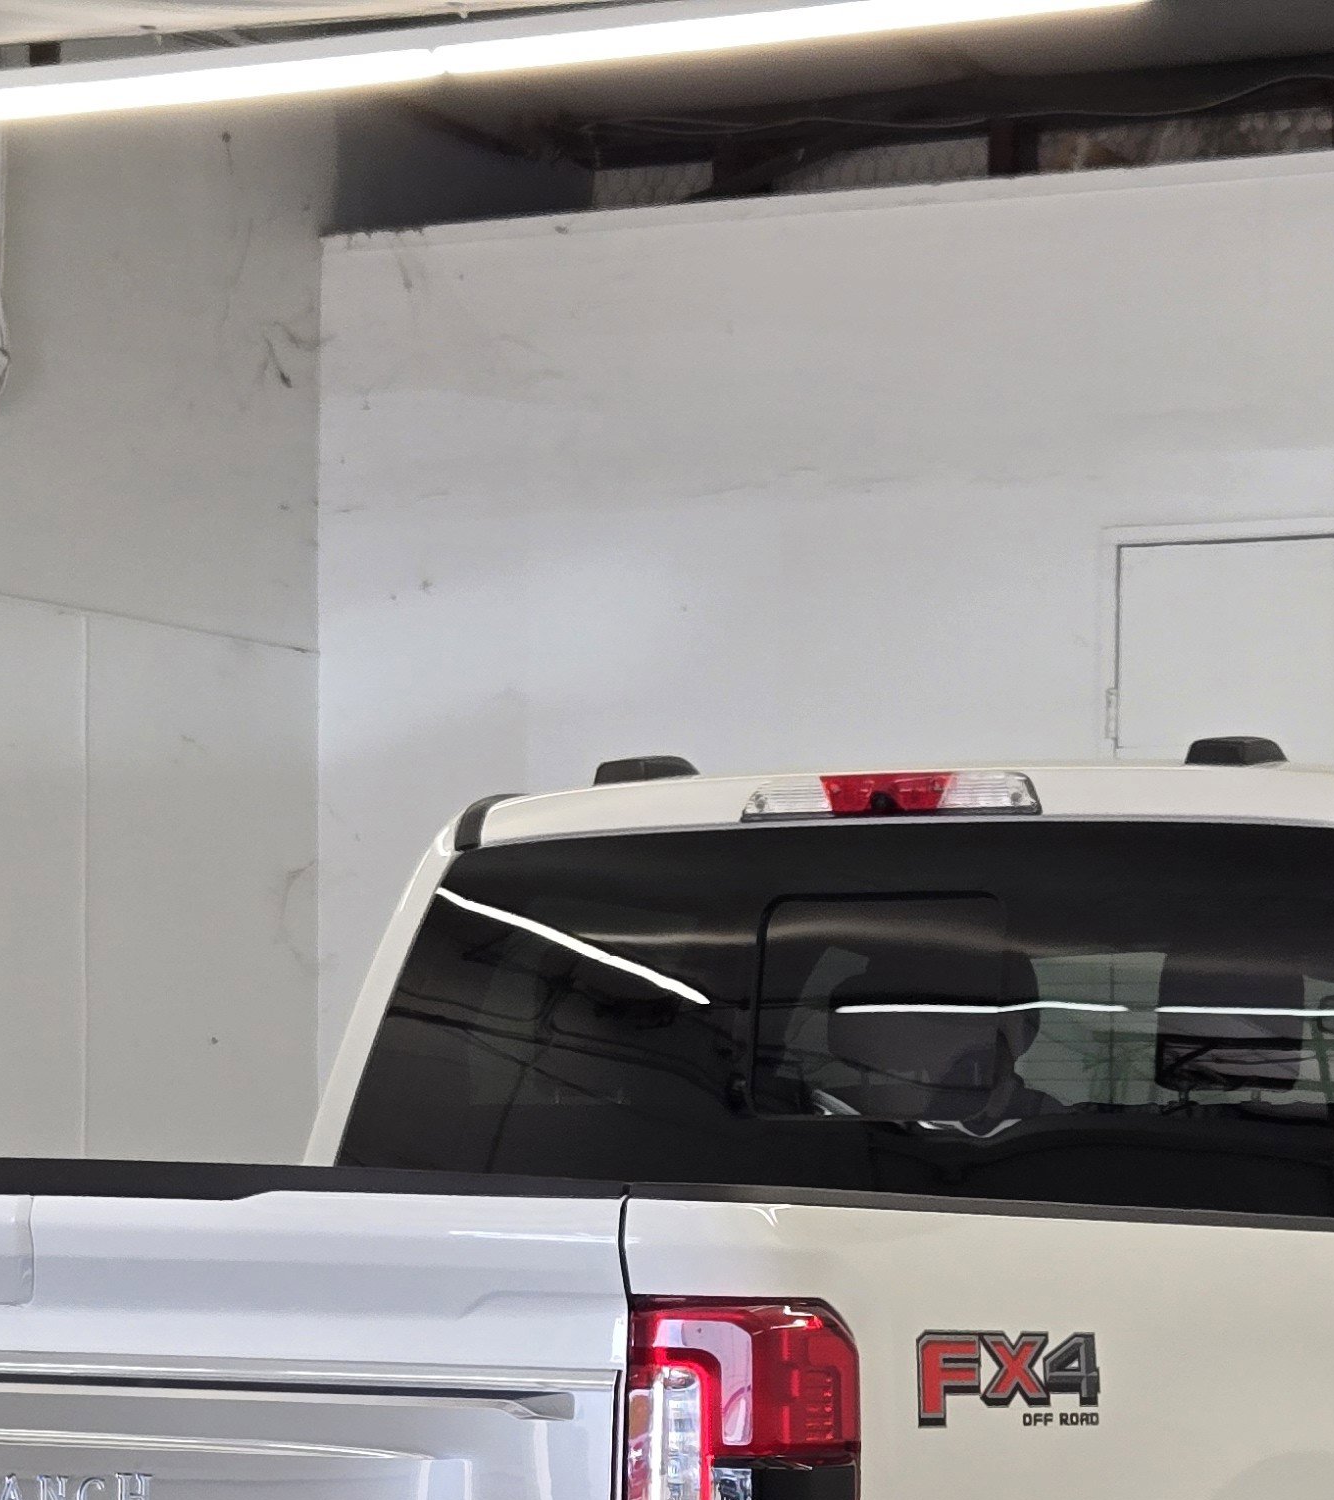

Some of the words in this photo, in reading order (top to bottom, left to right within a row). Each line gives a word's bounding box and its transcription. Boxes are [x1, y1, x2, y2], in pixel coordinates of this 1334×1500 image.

[916, 1329, 1100, 1428] FX4
[1022, 1412, 1054, 1427] OFF
[1059, 1412, 1099, 1427] ROAD
